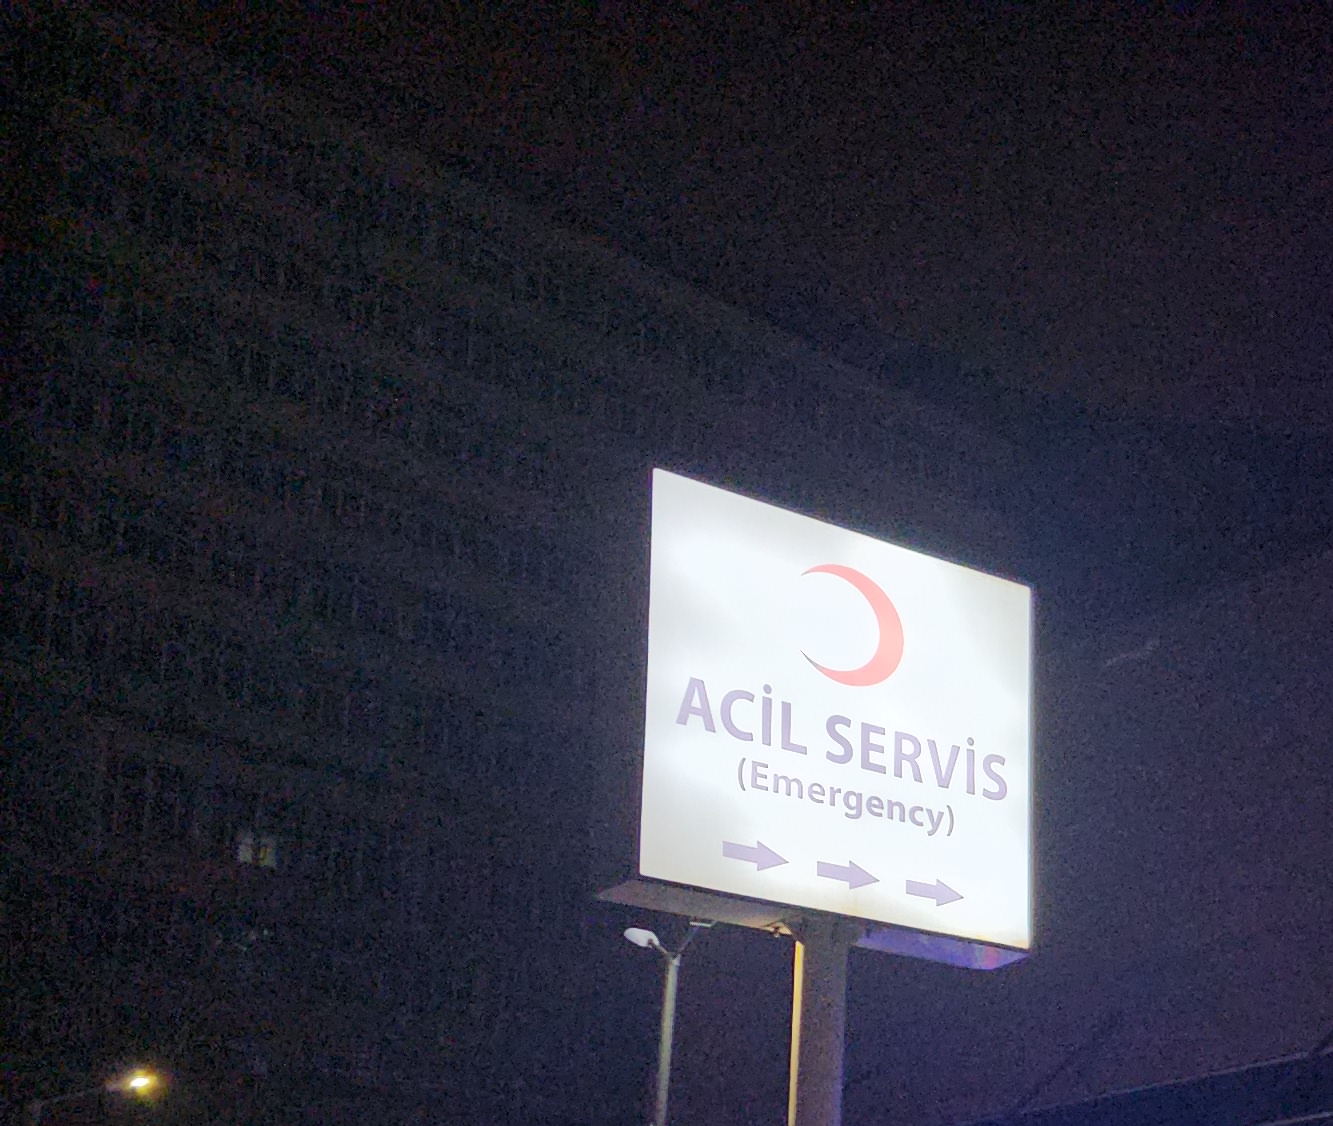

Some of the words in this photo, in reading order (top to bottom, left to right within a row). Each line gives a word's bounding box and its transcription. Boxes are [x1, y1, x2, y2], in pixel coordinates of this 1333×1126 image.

[675, 676, 808, 756] ACİL
[825, 713, 1009, 801] SERVİS
[737, 758, 955, 836] (Emergency)
